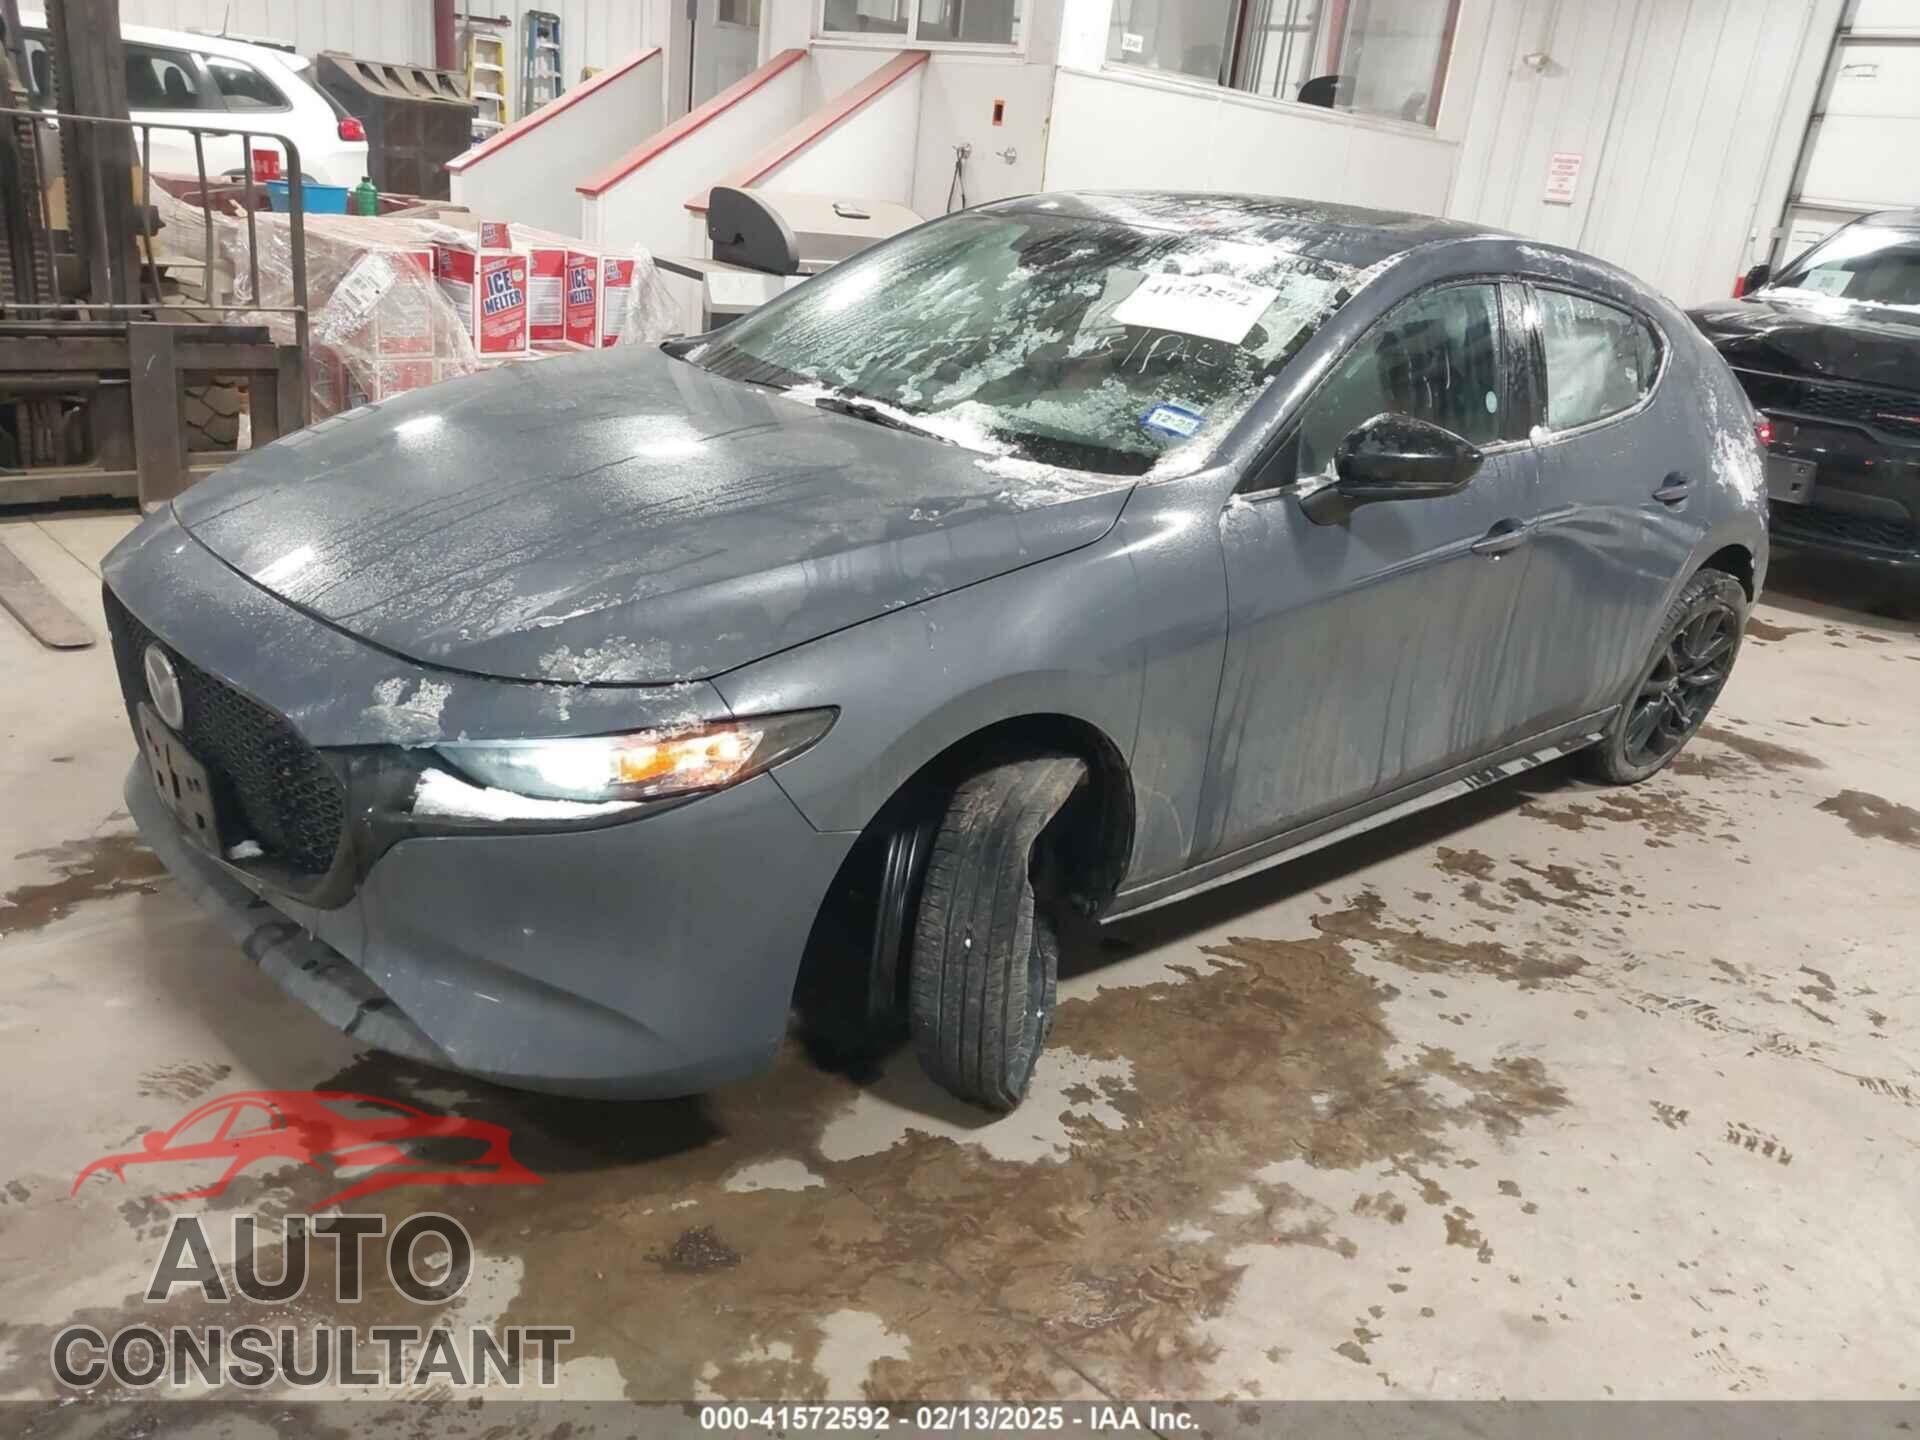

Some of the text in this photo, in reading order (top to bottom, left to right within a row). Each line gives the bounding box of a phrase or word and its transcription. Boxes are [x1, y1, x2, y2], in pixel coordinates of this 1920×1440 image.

[487, 270, 513, 296] ICE
[570, 267, 587, 289] ICE
[484, 290, 522, 314] MELTER
[569, 288, 593, 304] MELTER
